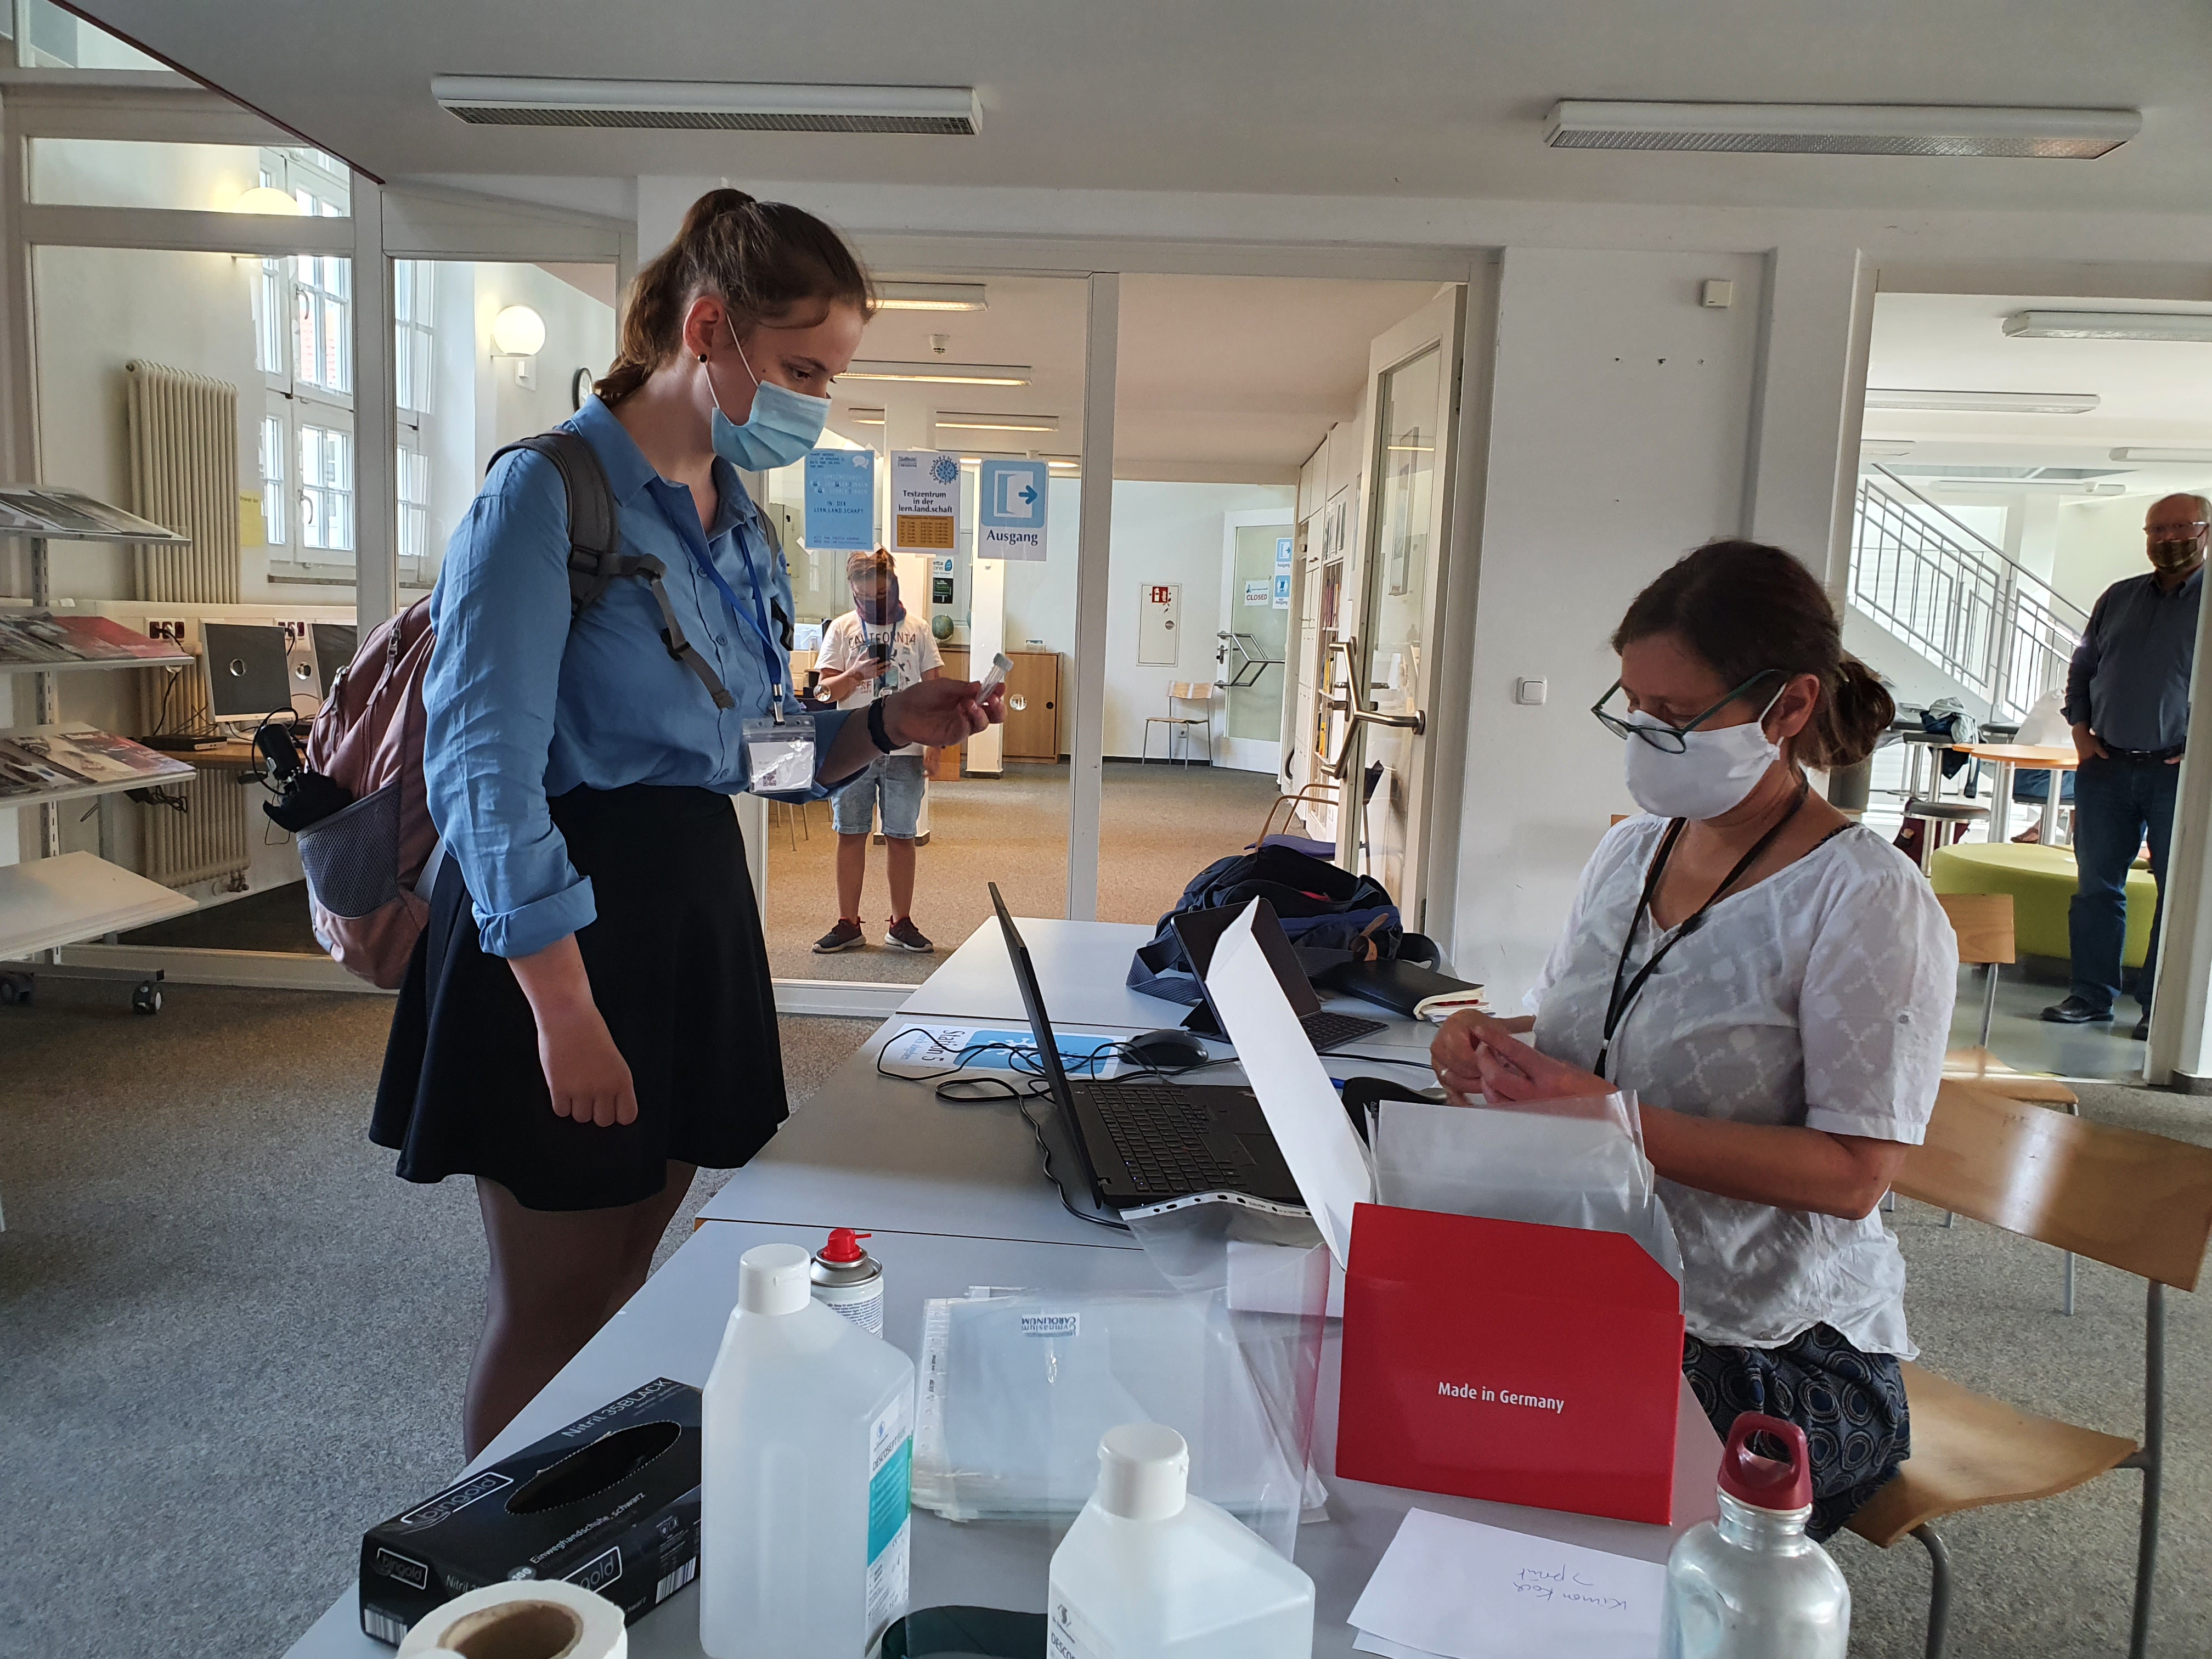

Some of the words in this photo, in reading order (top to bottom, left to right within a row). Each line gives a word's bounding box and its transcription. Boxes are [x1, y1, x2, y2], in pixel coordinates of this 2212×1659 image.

[902, 489, 946, 498] Testzentrum
[898, 504, 953, 513] lern.land.schaft
[986, 529, 1039, 546] Ausgang
[848, 631, 916, 649] CALIFONIA
[926, 1029, 966, 1054] Station
[1022, 1316, 1076, 1325] CAROLINUM
[1022, 1323, 1076, 1332] Gymnasium
[1438, 1381, 1477, 1400] Made
[1481, 1385, 1495, 1402] in
[1499, 1390, 1565, 1414] Germany
[561, 1415, 607, 1438] Nitril
[872, 1435, 899, 1471] DESCOSEPT
[415, 1478, 496, 1520] bingold
[611, 1492, 646, 1518] schwarz
[382, 1554, 422, 1582] bingold
[579, 1555, 614, 1590] gold
[624, 1596, 647, 1615] chwarz
[1051, 1632, 1076, 1659] DESCO
